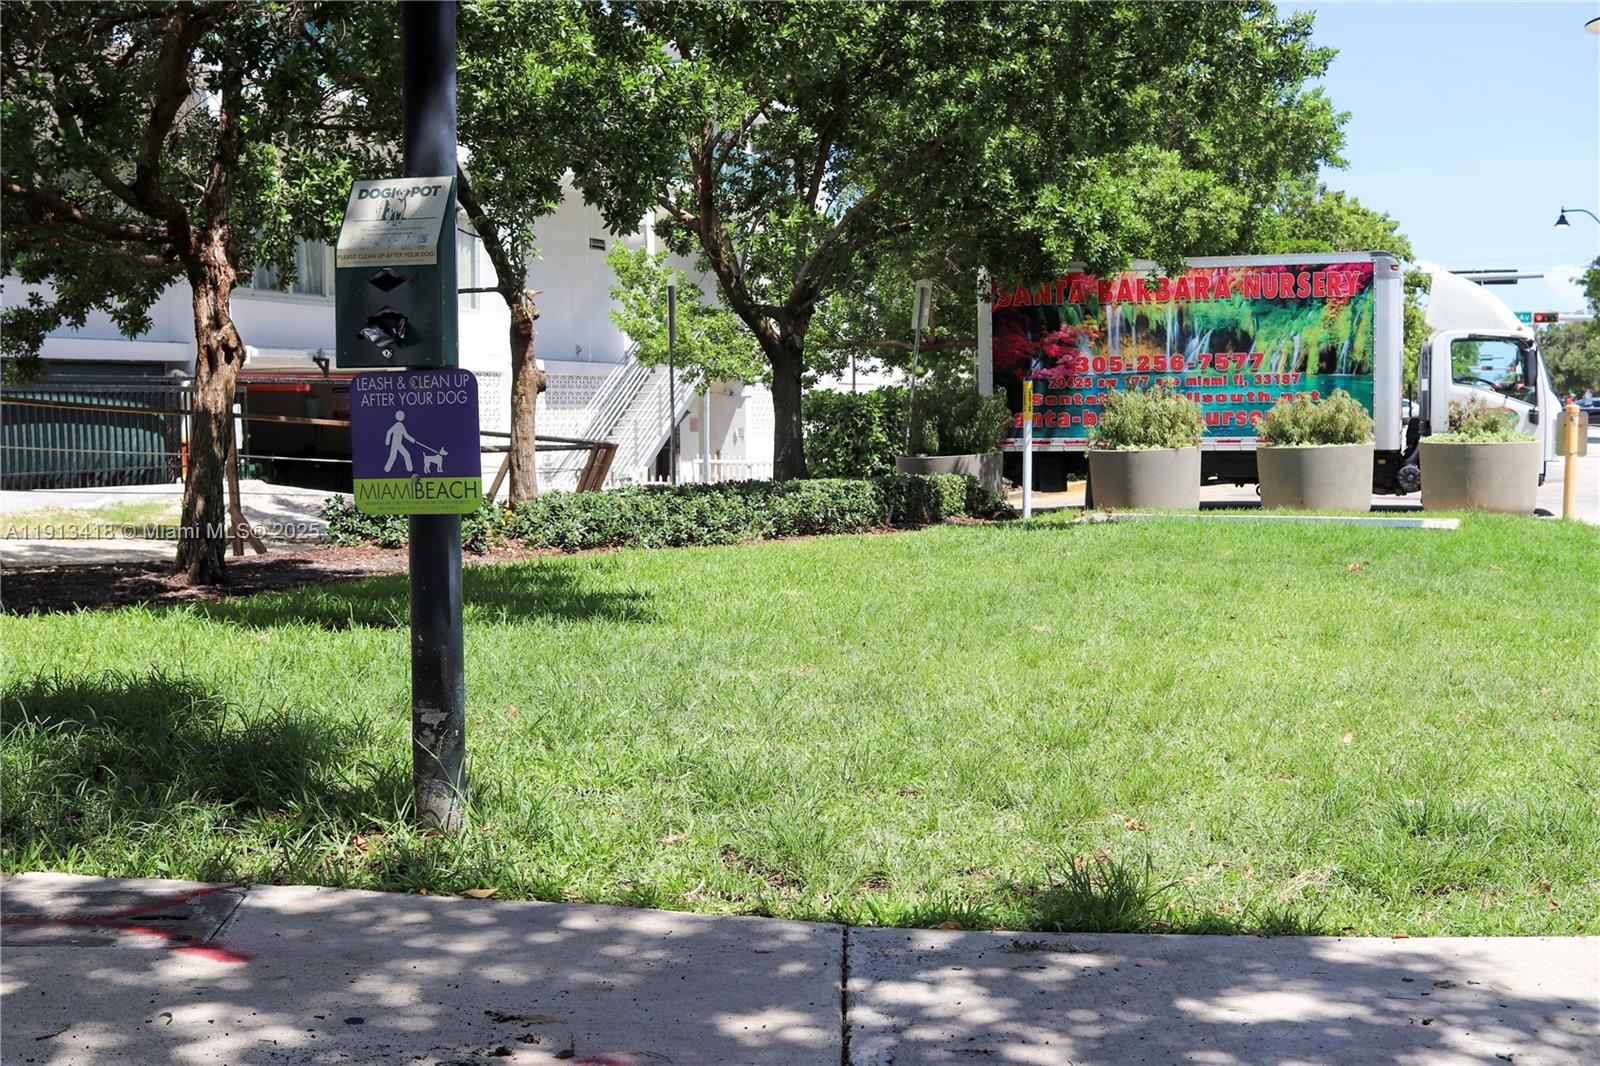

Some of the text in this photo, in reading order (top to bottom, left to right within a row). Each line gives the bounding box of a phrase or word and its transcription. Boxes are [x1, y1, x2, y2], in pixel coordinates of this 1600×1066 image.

[1098, 274, 1232, 303] BARBARA
[1243, 270, 1361, 299] NURSERY
[1075, 352, 1264, 373] 305-256-7577
[356, 373, 470, 391] LEASH & CLEAN UP
[361, 390, 468, 407] AFTER YOUR DOG
